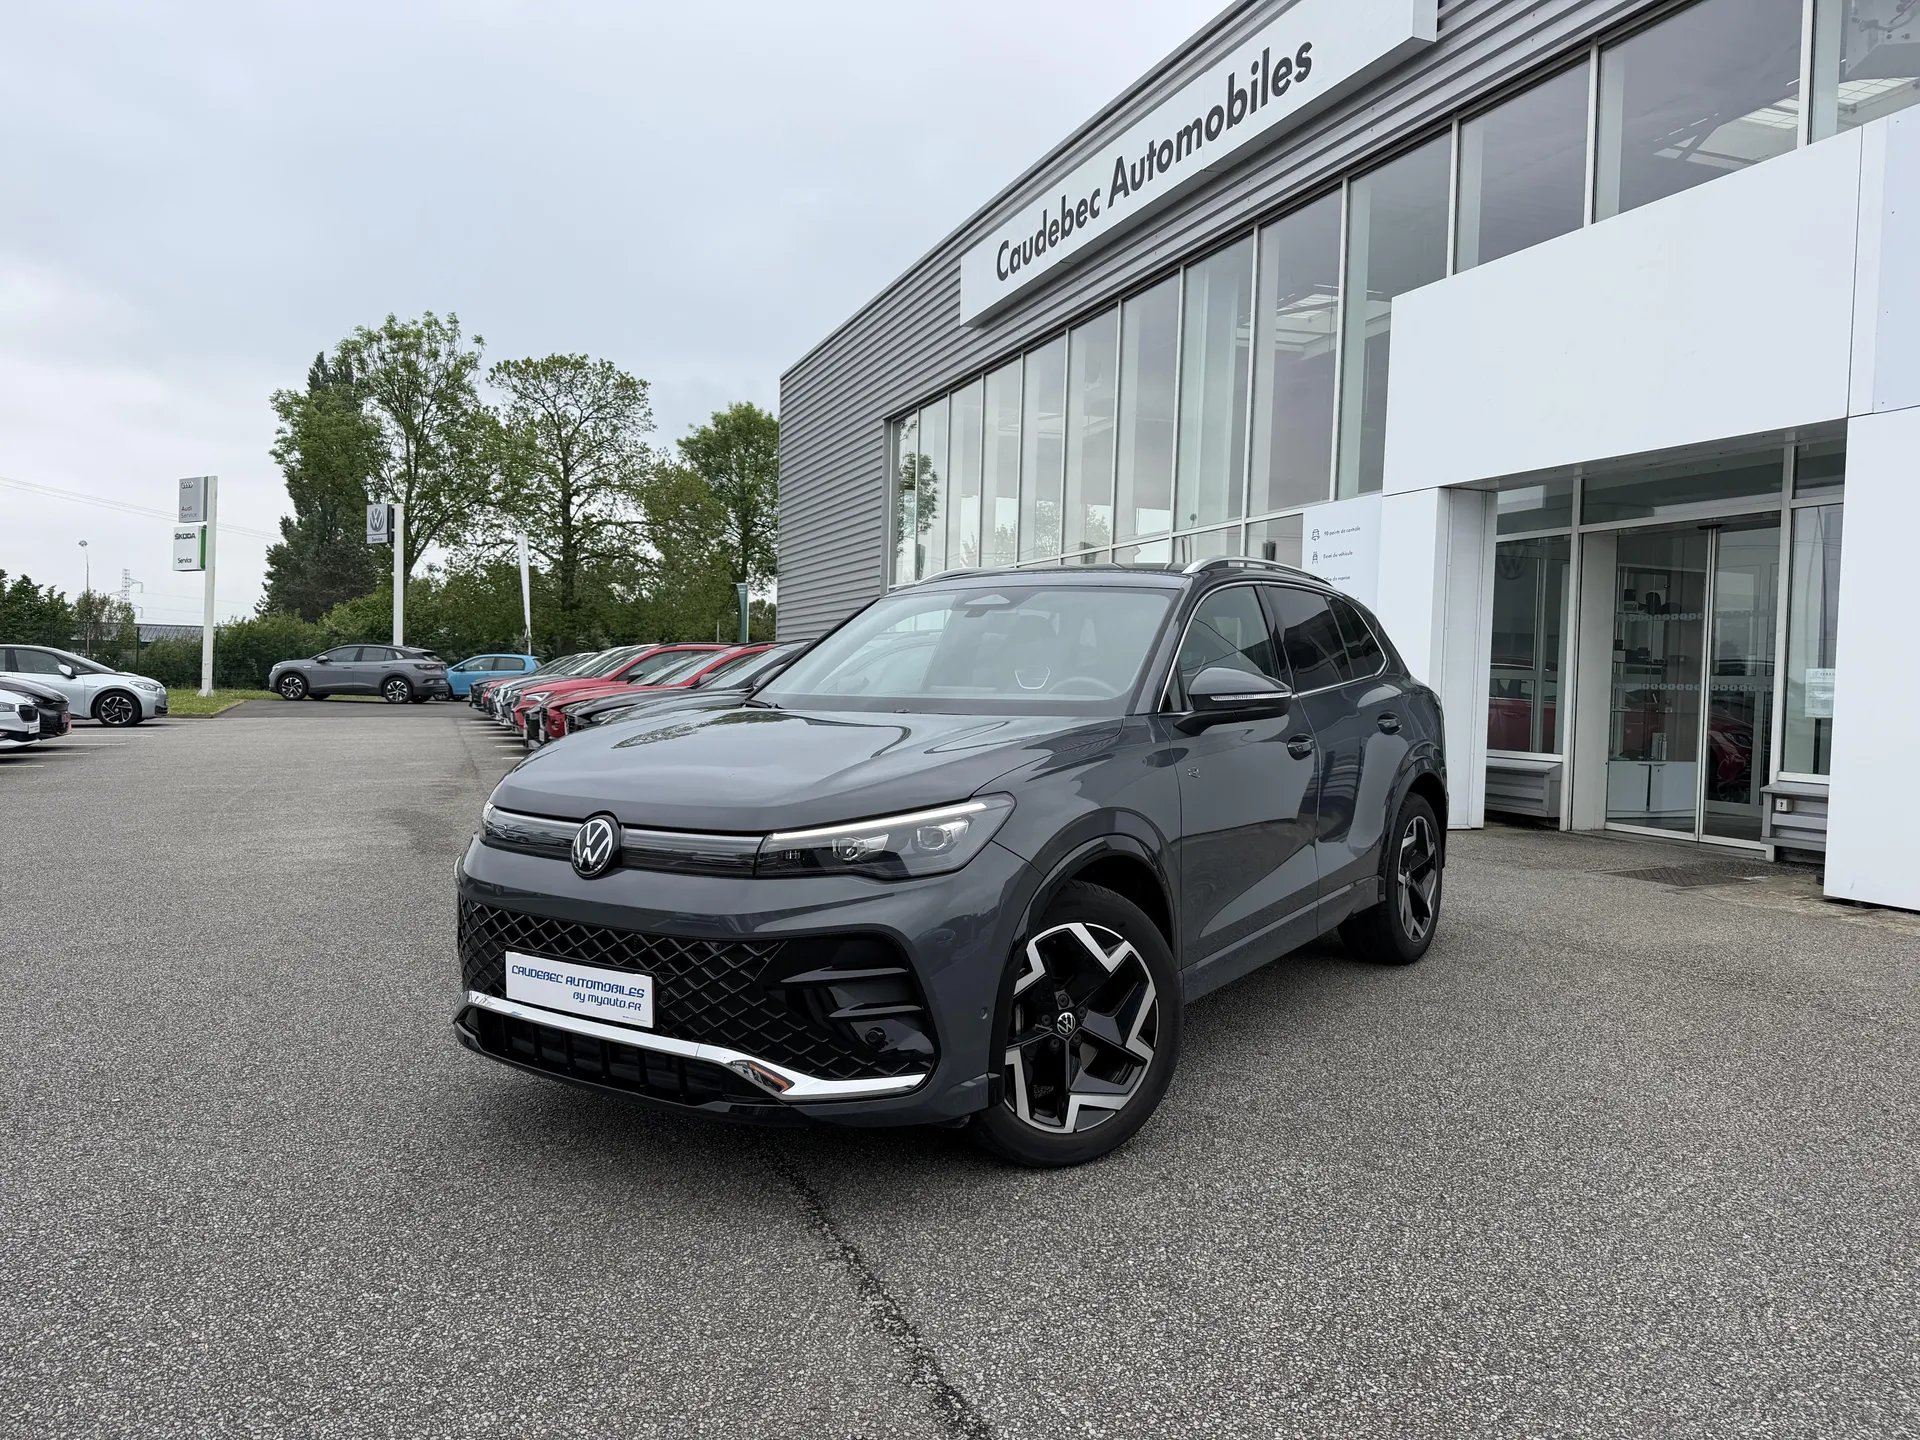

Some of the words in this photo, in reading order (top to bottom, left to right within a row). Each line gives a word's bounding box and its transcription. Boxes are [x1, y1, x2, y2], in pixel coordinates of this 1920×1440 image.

[995, 185, 1101, 281] Caudebec
[1107, 41, 1313, 209] Automobiles
[511, 964, 564, 984] CAUDEBEC
[565, 975, 645, 999] AUTOMOBILES
